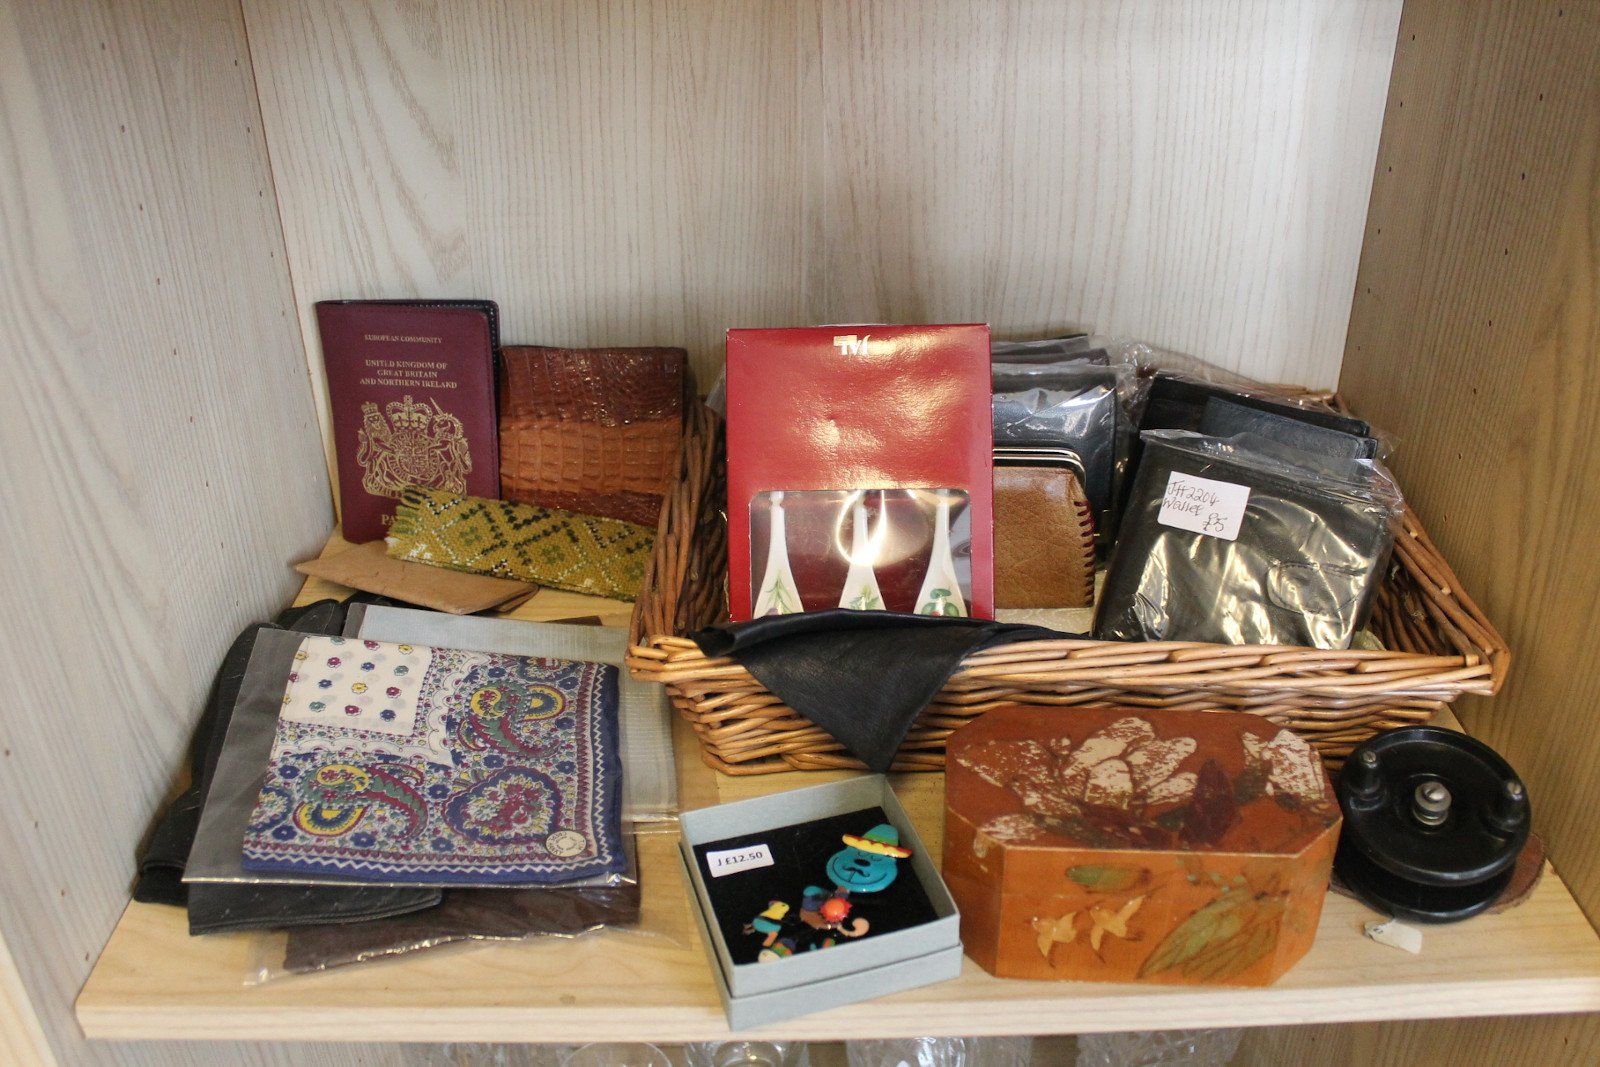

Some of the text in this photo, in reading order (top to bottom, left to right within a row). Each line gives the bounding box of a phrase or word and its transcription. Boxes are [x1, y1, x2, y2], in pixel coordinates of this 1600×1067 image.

[364, 334, 399, 342] EUROPEAN
[396, 361, 434, 369] KINGDOM
[1202, 513, 1228, 532] £5
[725, 851, 763, 865] £12.50
